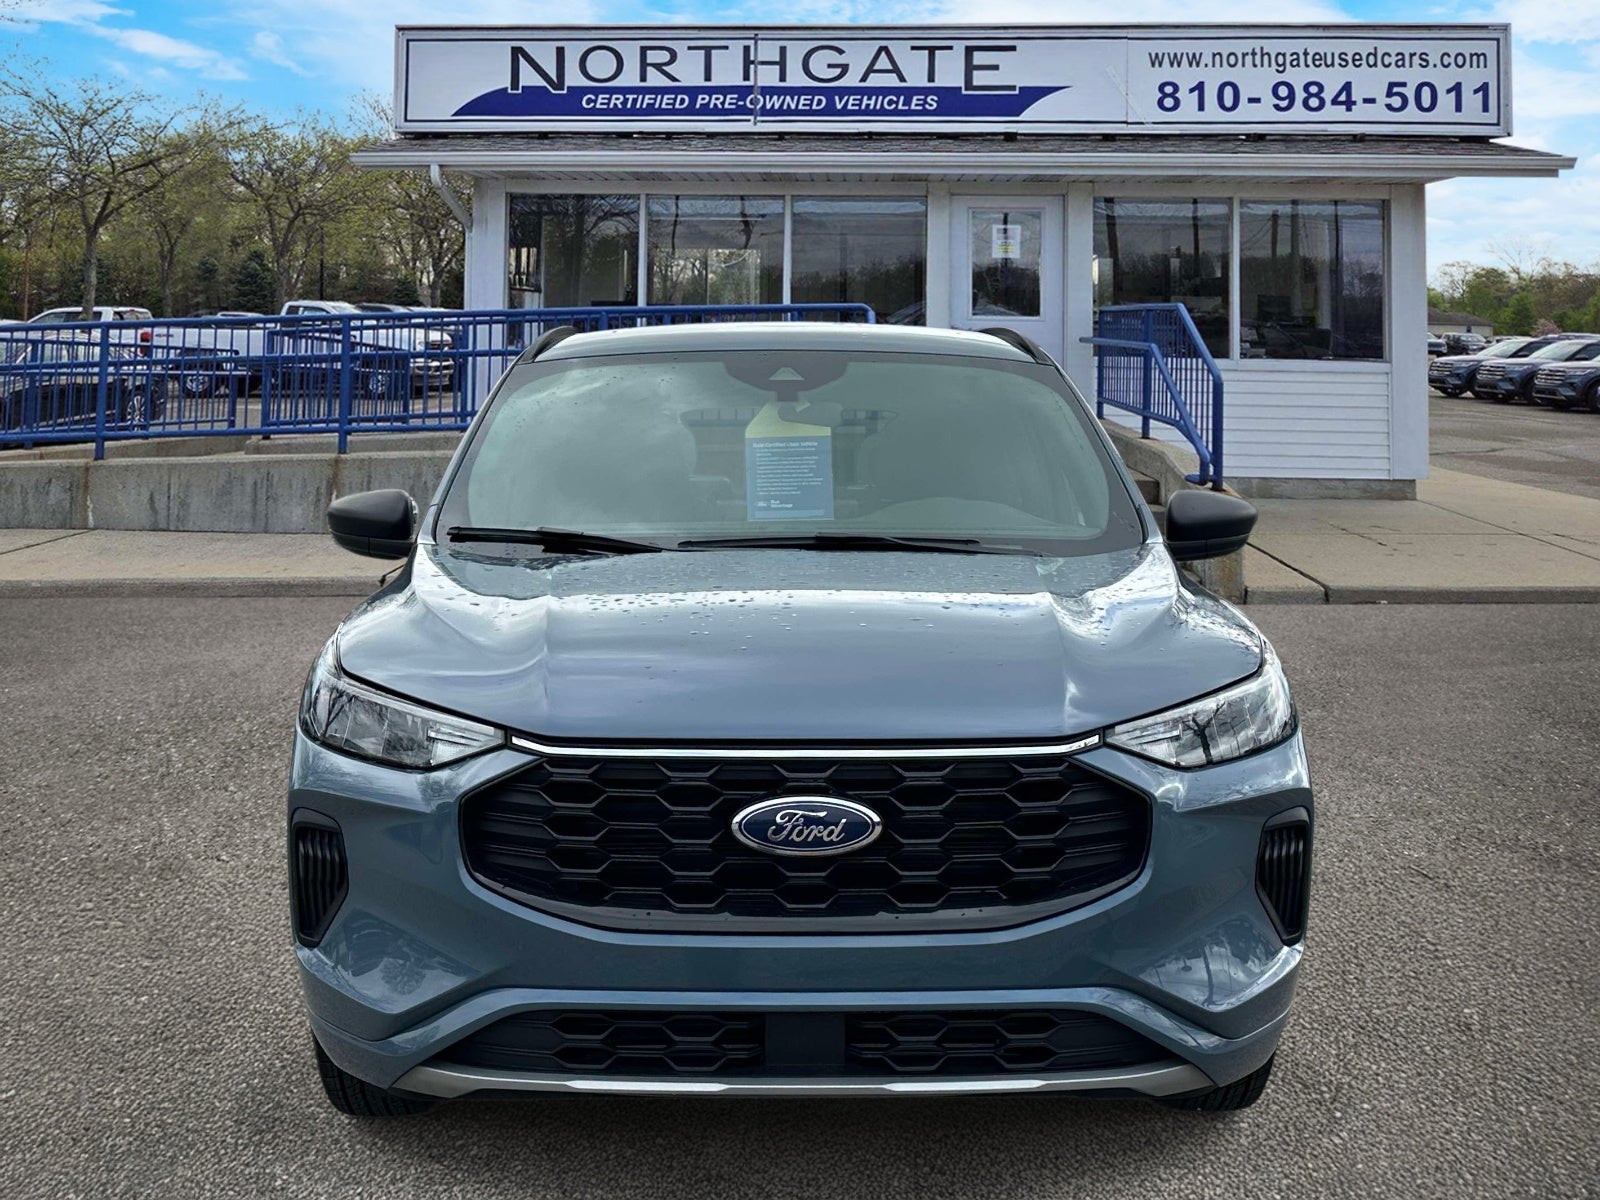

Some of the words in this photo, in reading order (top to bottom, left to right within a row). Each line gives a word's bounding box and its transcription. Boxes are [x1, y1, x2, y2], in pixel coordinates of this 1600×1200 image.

[510, 45, 1017, 92] NORTHGATE
[1149, 47, 1488, 73] www.northgateusedcars.com
[581, 94, 689, 109] CERTIFIED
[695, 95, 827, 110] PRE-OWNED
[834, 95, 939, 110] VEHICLES
[1157, 81, 1491, 113] 810-984-5011
[767, 809, 847, 842] Ford
